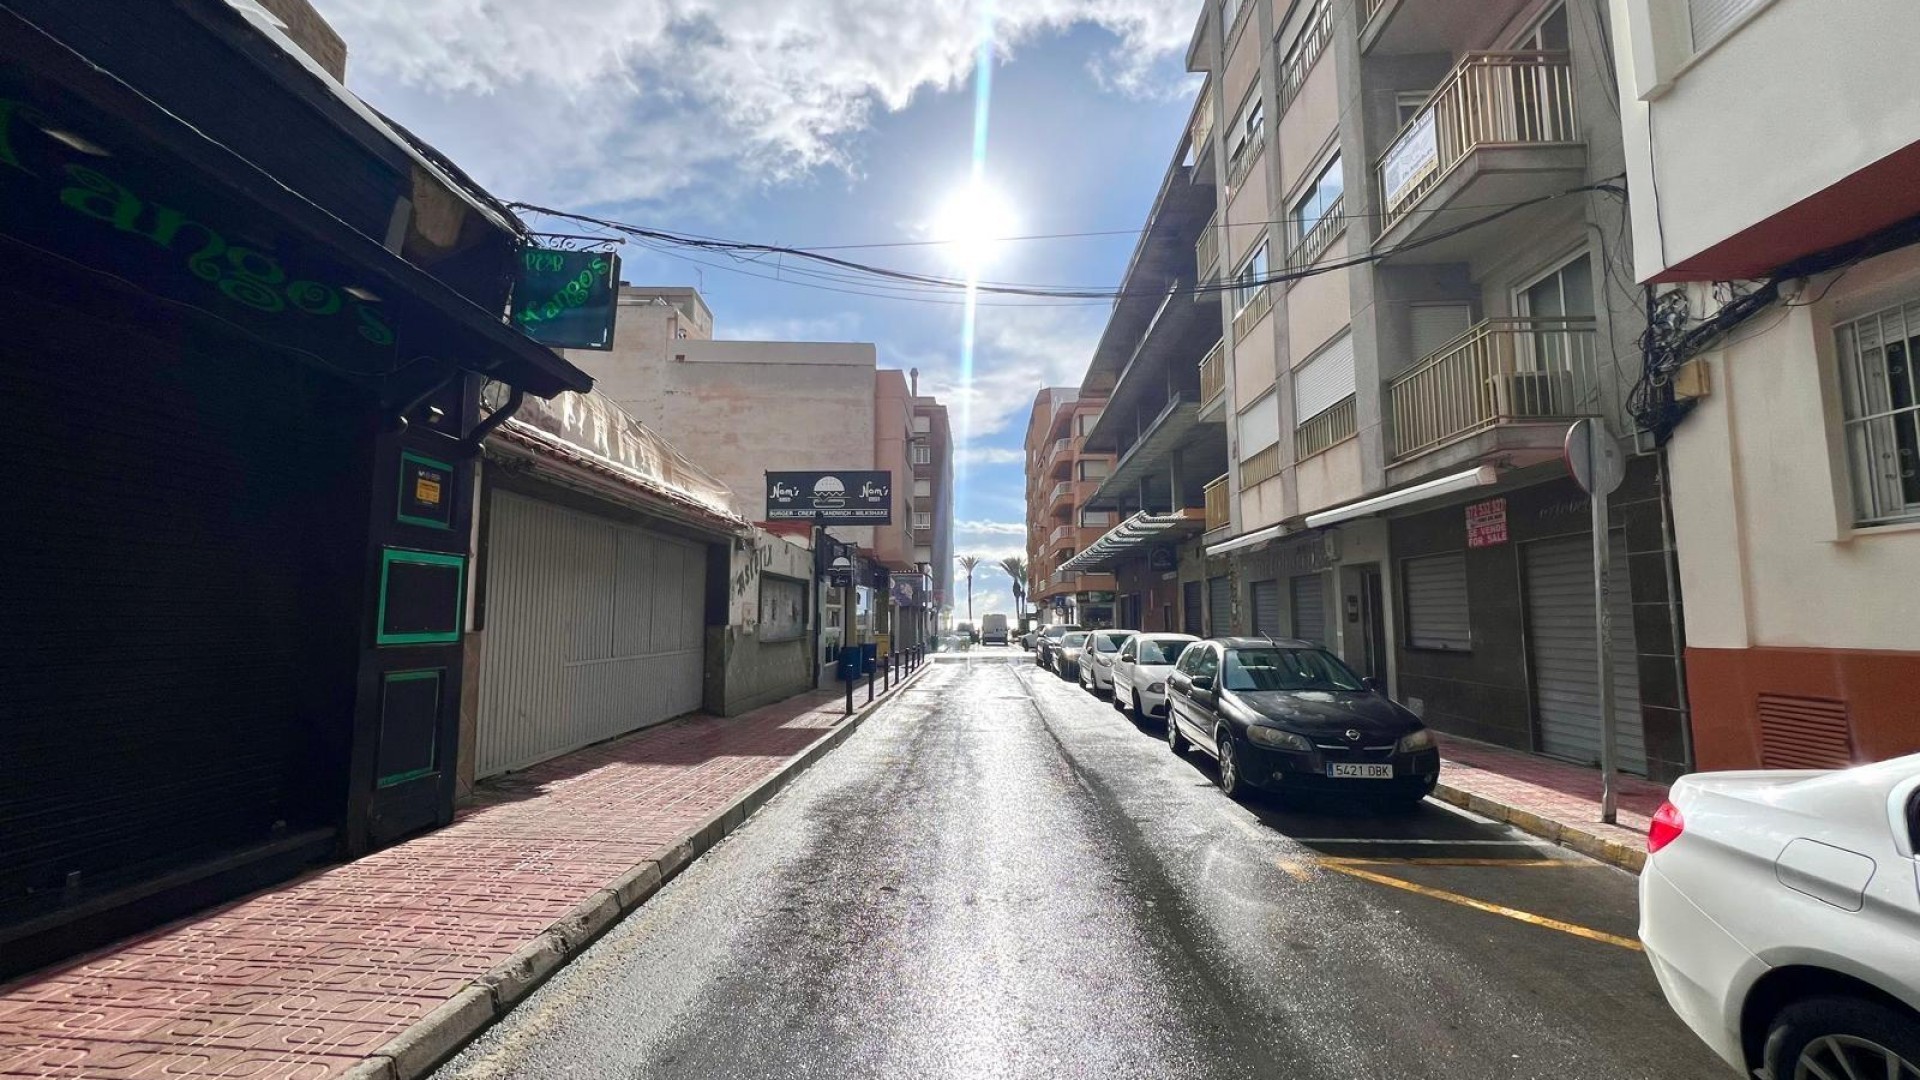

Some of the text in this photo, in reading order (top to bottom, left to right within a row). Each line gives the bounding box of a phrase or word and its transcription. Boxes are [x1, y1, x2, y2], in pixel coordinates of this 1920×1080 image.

[1480, 523, 1507, 535] VENDE
[1468, 531, 1507, 549] FOR SALE
[1336, 765, 1389, 777] 5421 DBK
